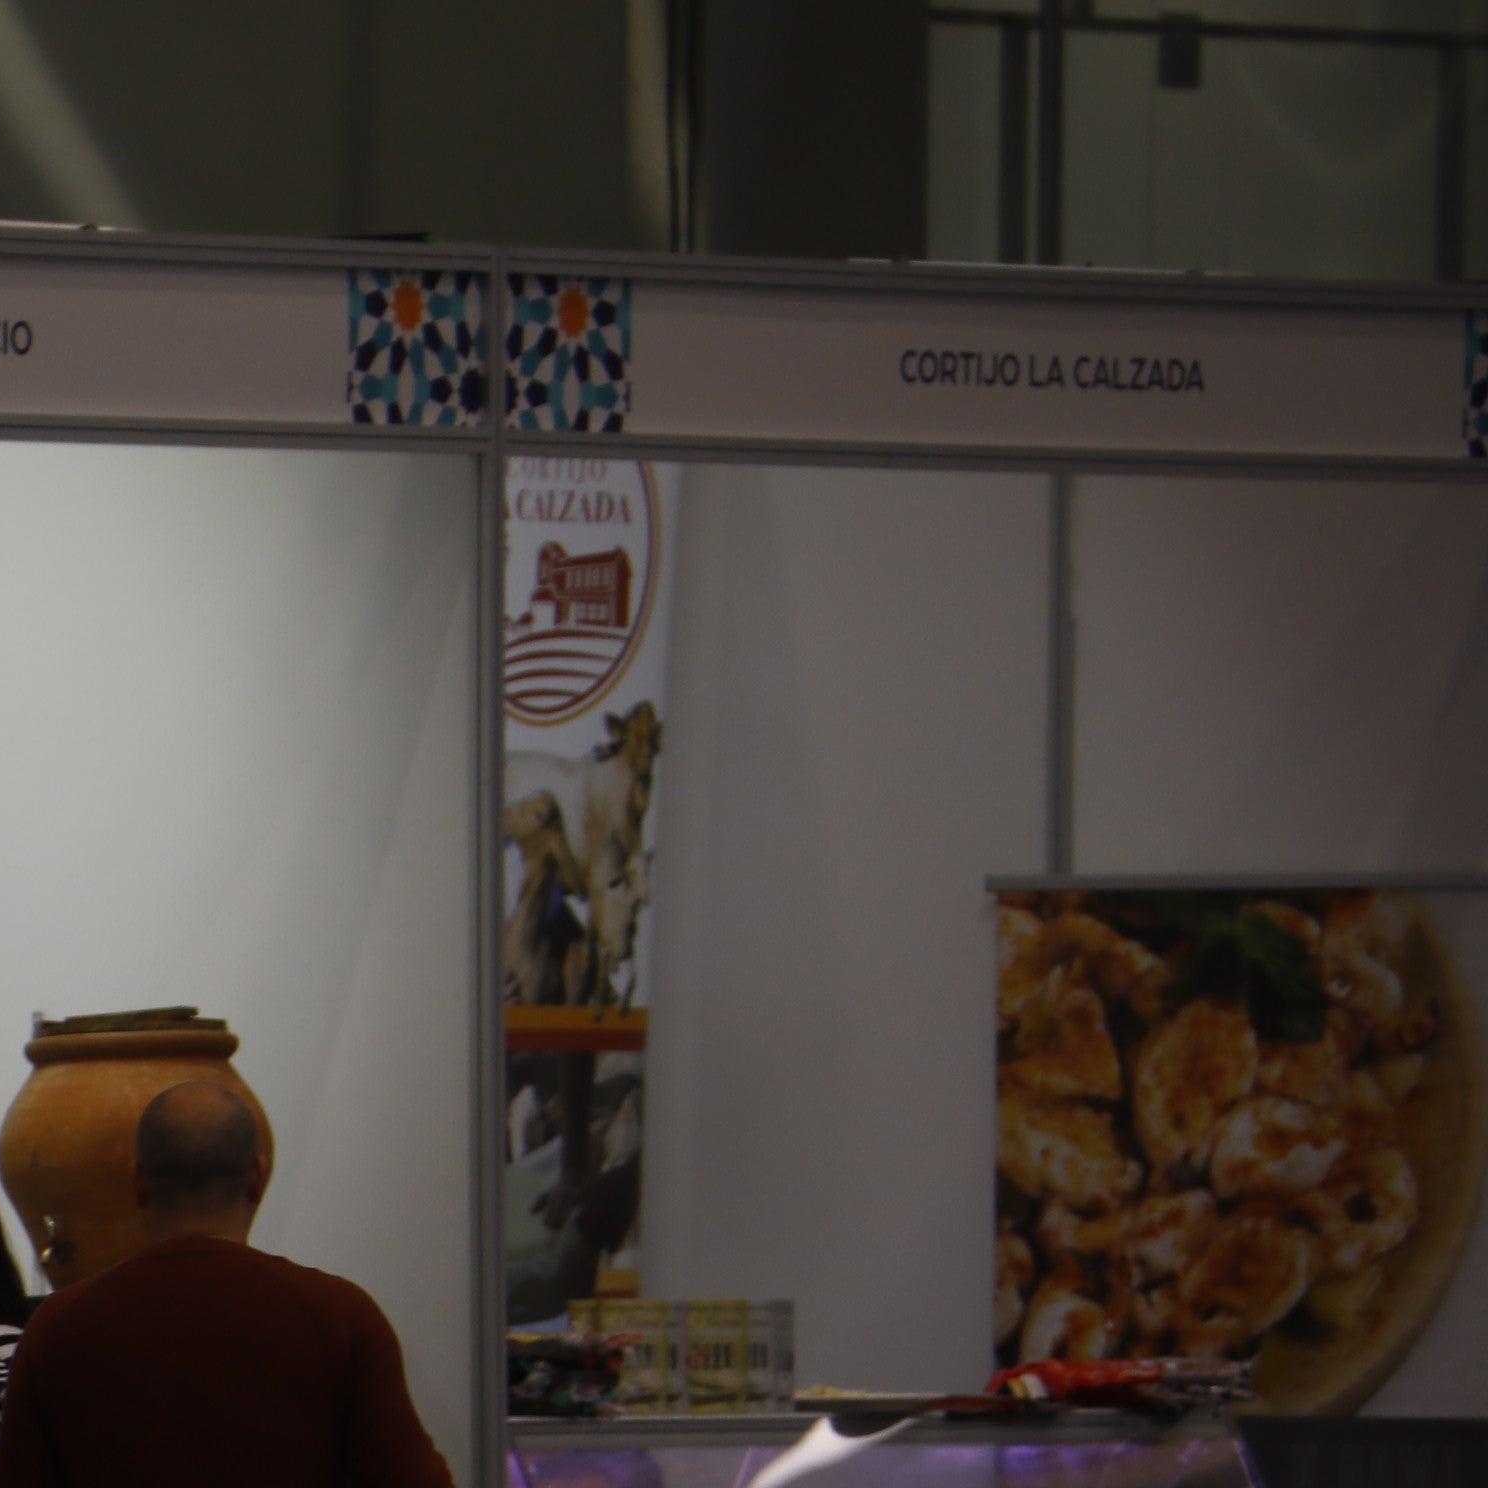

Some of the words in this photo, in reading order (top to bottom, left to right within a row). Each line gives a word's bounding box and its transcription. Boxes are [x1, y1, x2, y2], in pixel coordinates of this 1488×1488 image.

[899, 350, 1020, 387] CORTIJO
[1028, 354, 1065, 388] LA
[1073, 356, 1205, 392] CALZADA
